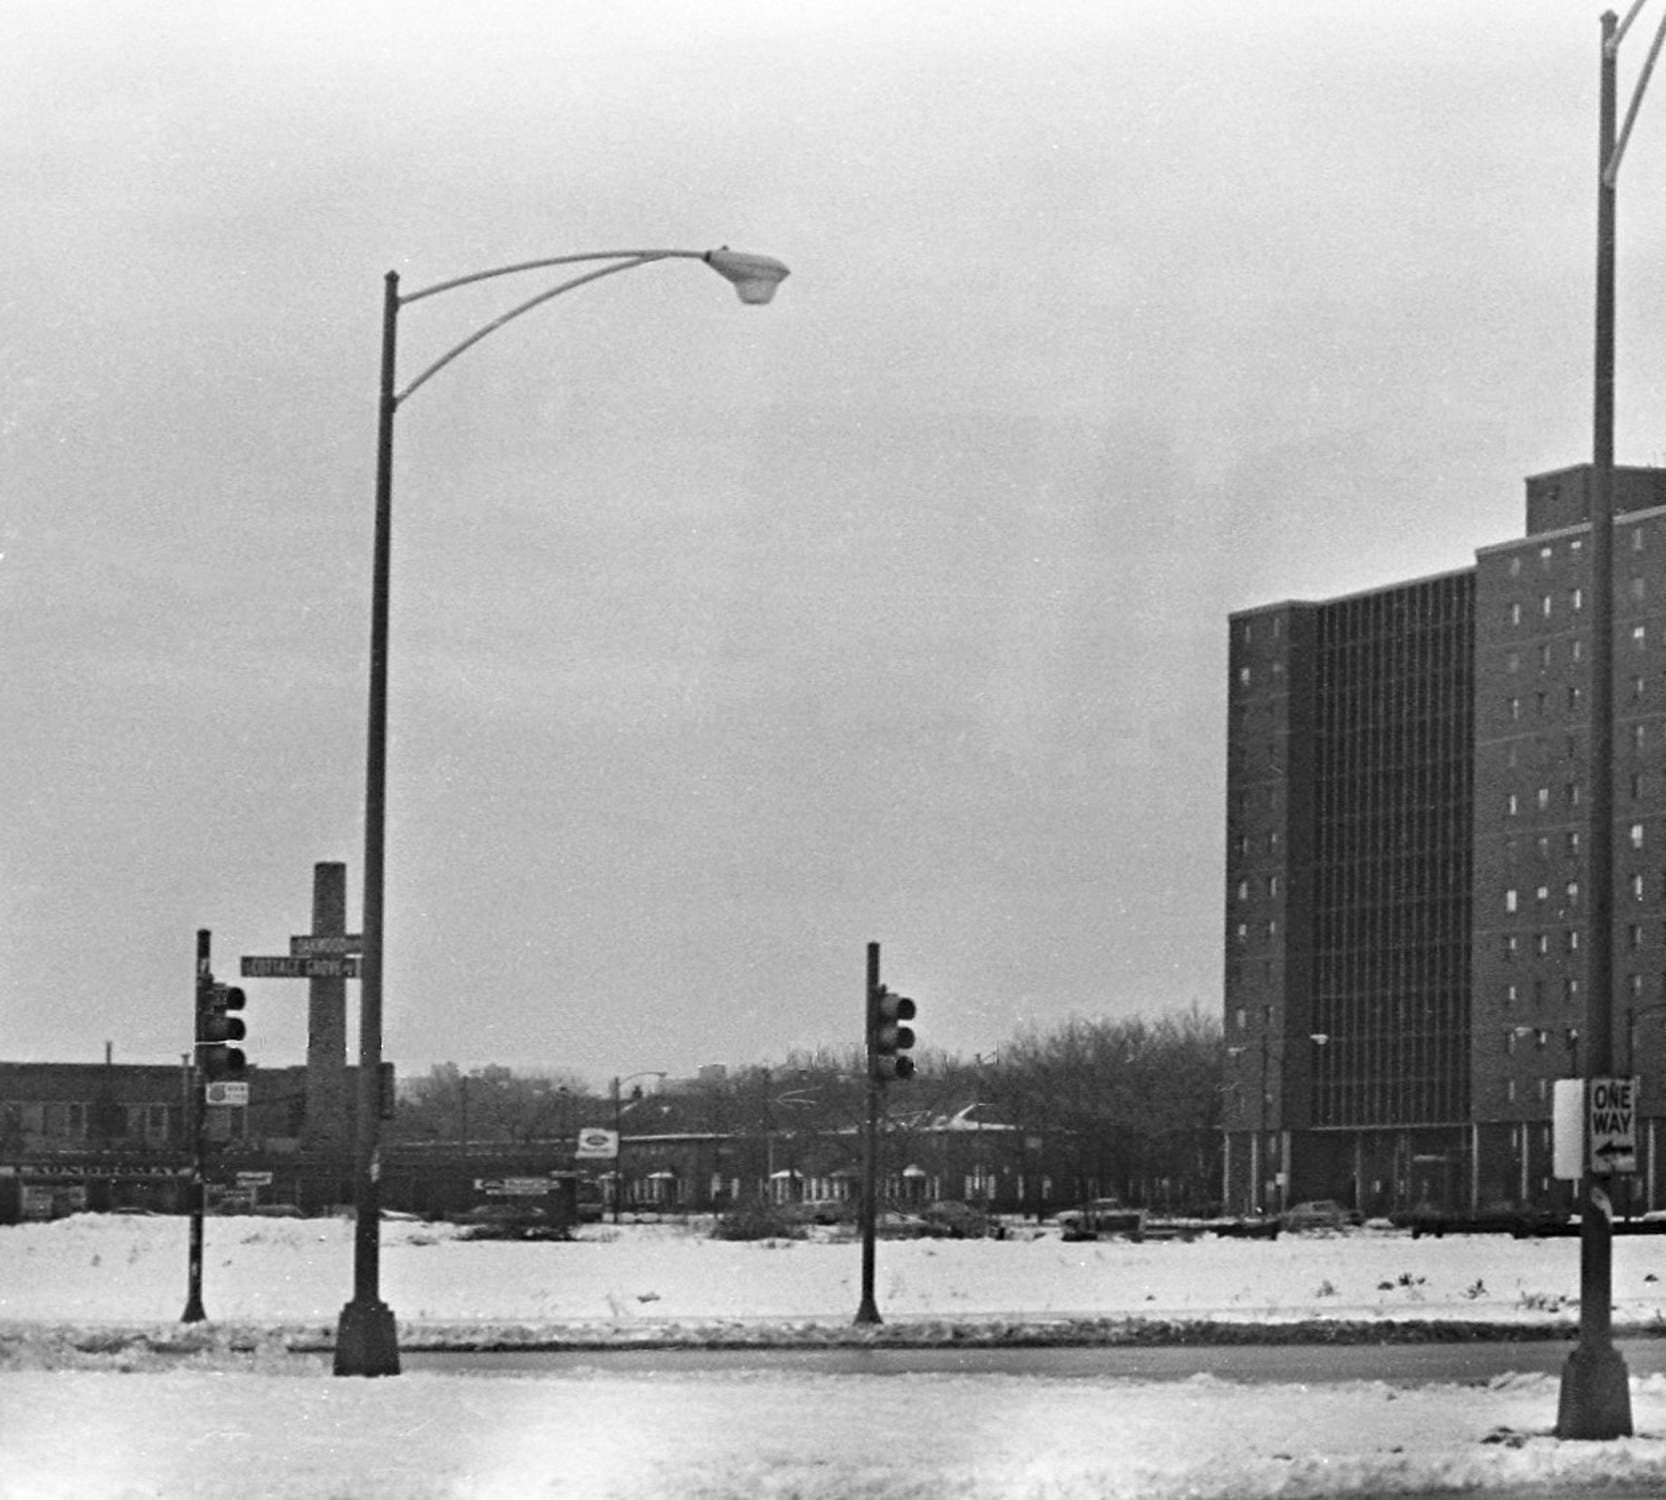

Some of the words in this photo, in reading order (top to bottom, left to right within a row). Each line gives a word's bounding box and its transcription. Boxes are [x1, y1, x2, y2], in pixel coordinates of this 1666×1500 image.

[250, 958, 300, 976] COTTAGE
[305, 959, 342, 976] GROVE
[1594, 1085, 1631, 1109] ONE
[1593, 1111, 1632, 1134] WAY
